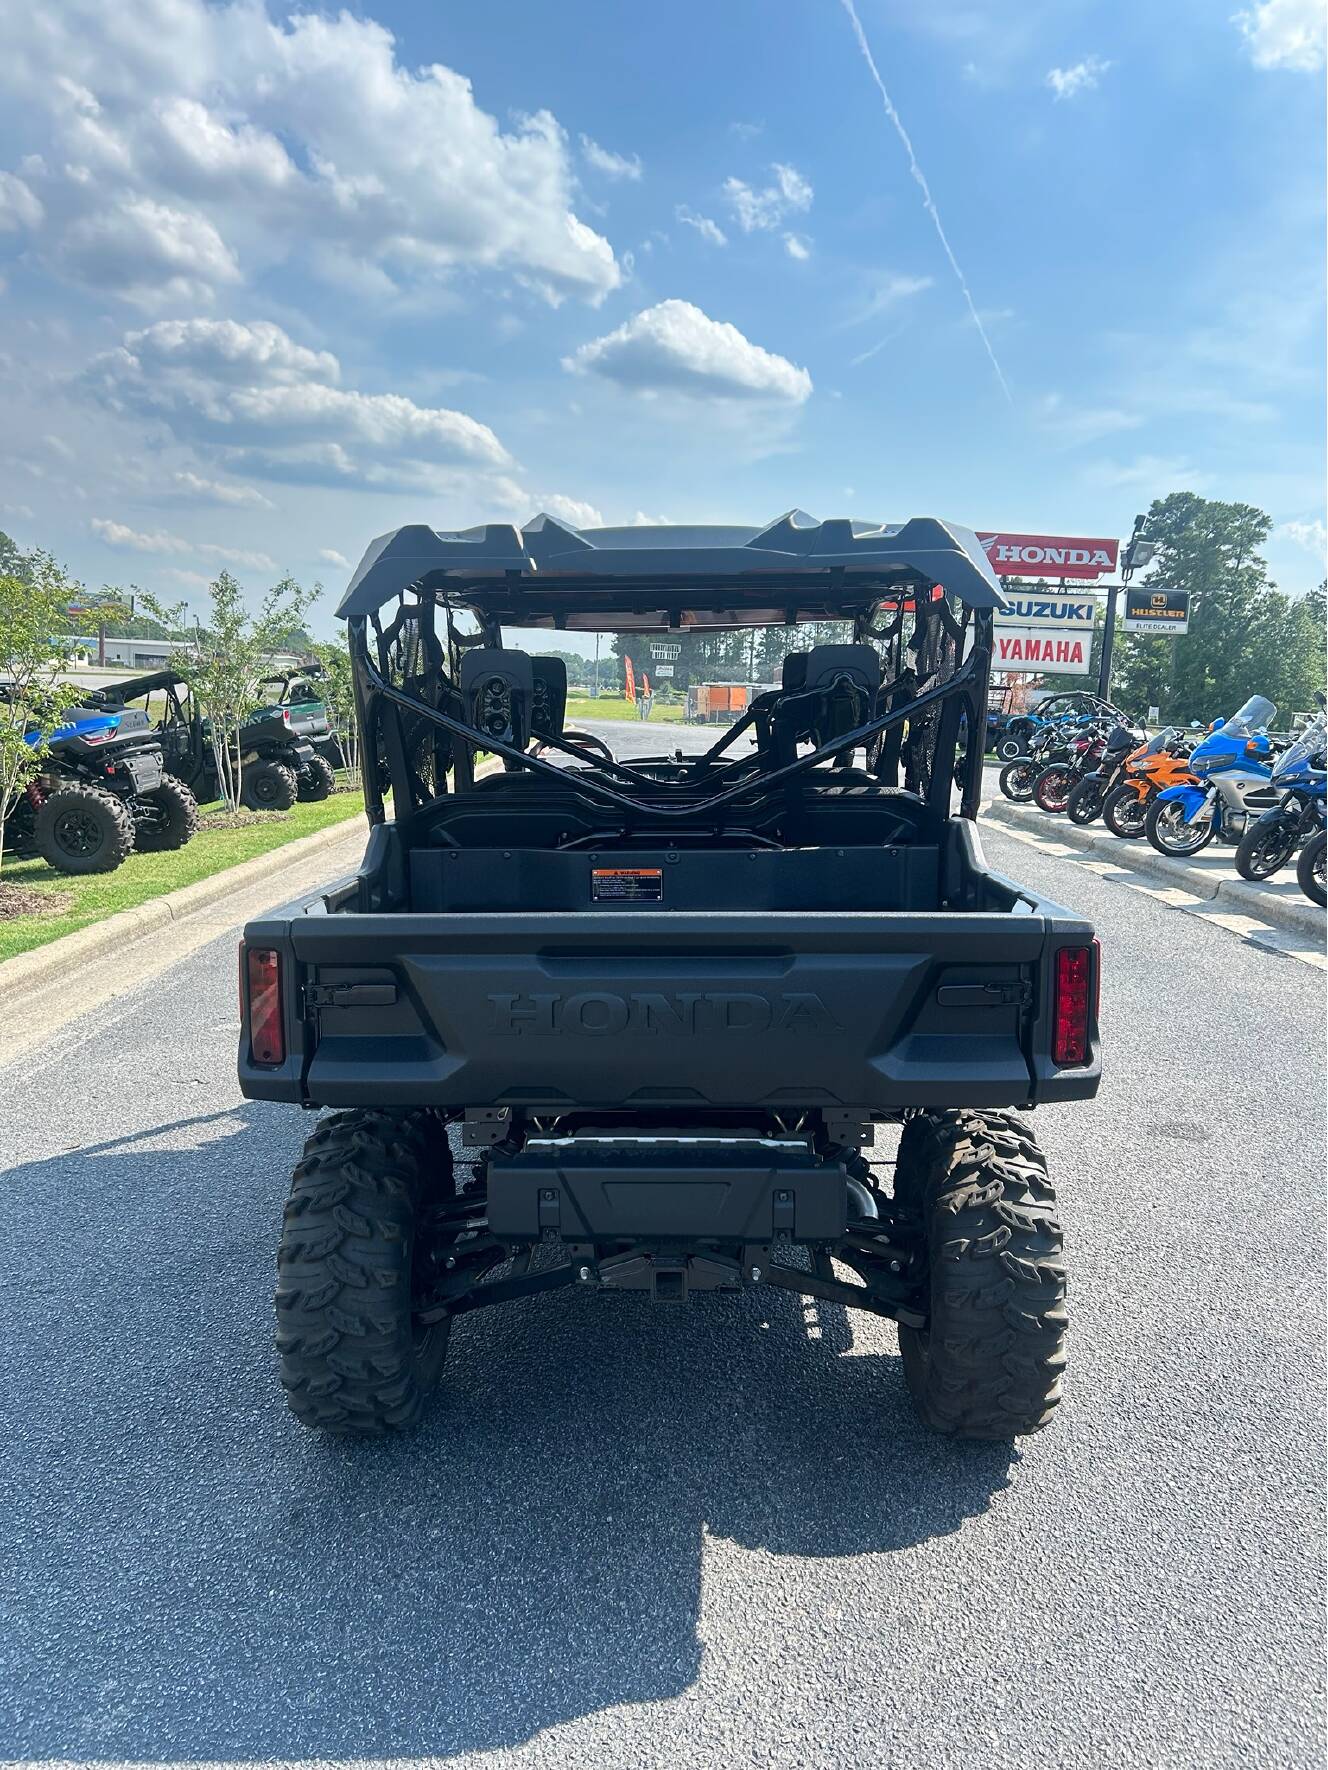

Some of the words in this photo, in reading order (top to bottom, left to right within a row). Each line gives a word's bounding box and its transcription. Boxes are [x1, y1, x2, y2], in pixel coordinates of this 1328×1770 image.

[996, 545, 1114, 567] HONDA
[999, 600, 1093, 620] SUZUKI
[1131, 608, 1185, 618] HUSTLER
[999, 638, 1083, 664] YAMAHA
[487, 992, 847, 1036] HONDA
